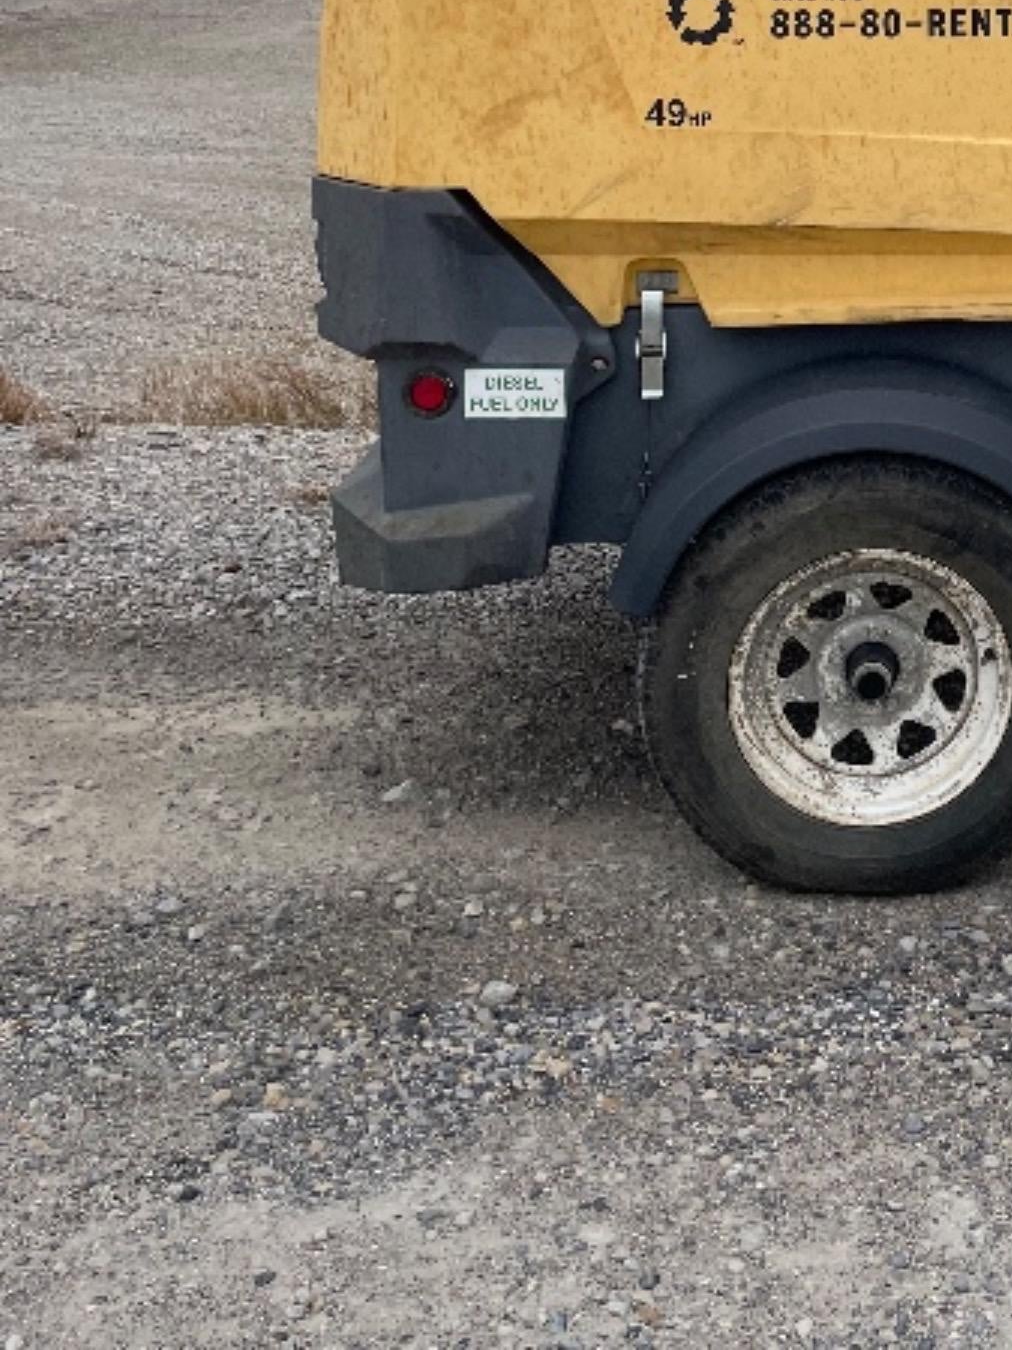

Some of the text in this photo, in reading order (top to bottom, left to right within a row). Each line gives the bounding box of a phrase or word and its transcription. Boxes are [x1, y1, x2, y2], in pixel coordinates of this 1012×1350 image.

[485, 376, 544, 391] DIESEL
[469, 396, 559, 412] FUEL ONLY
